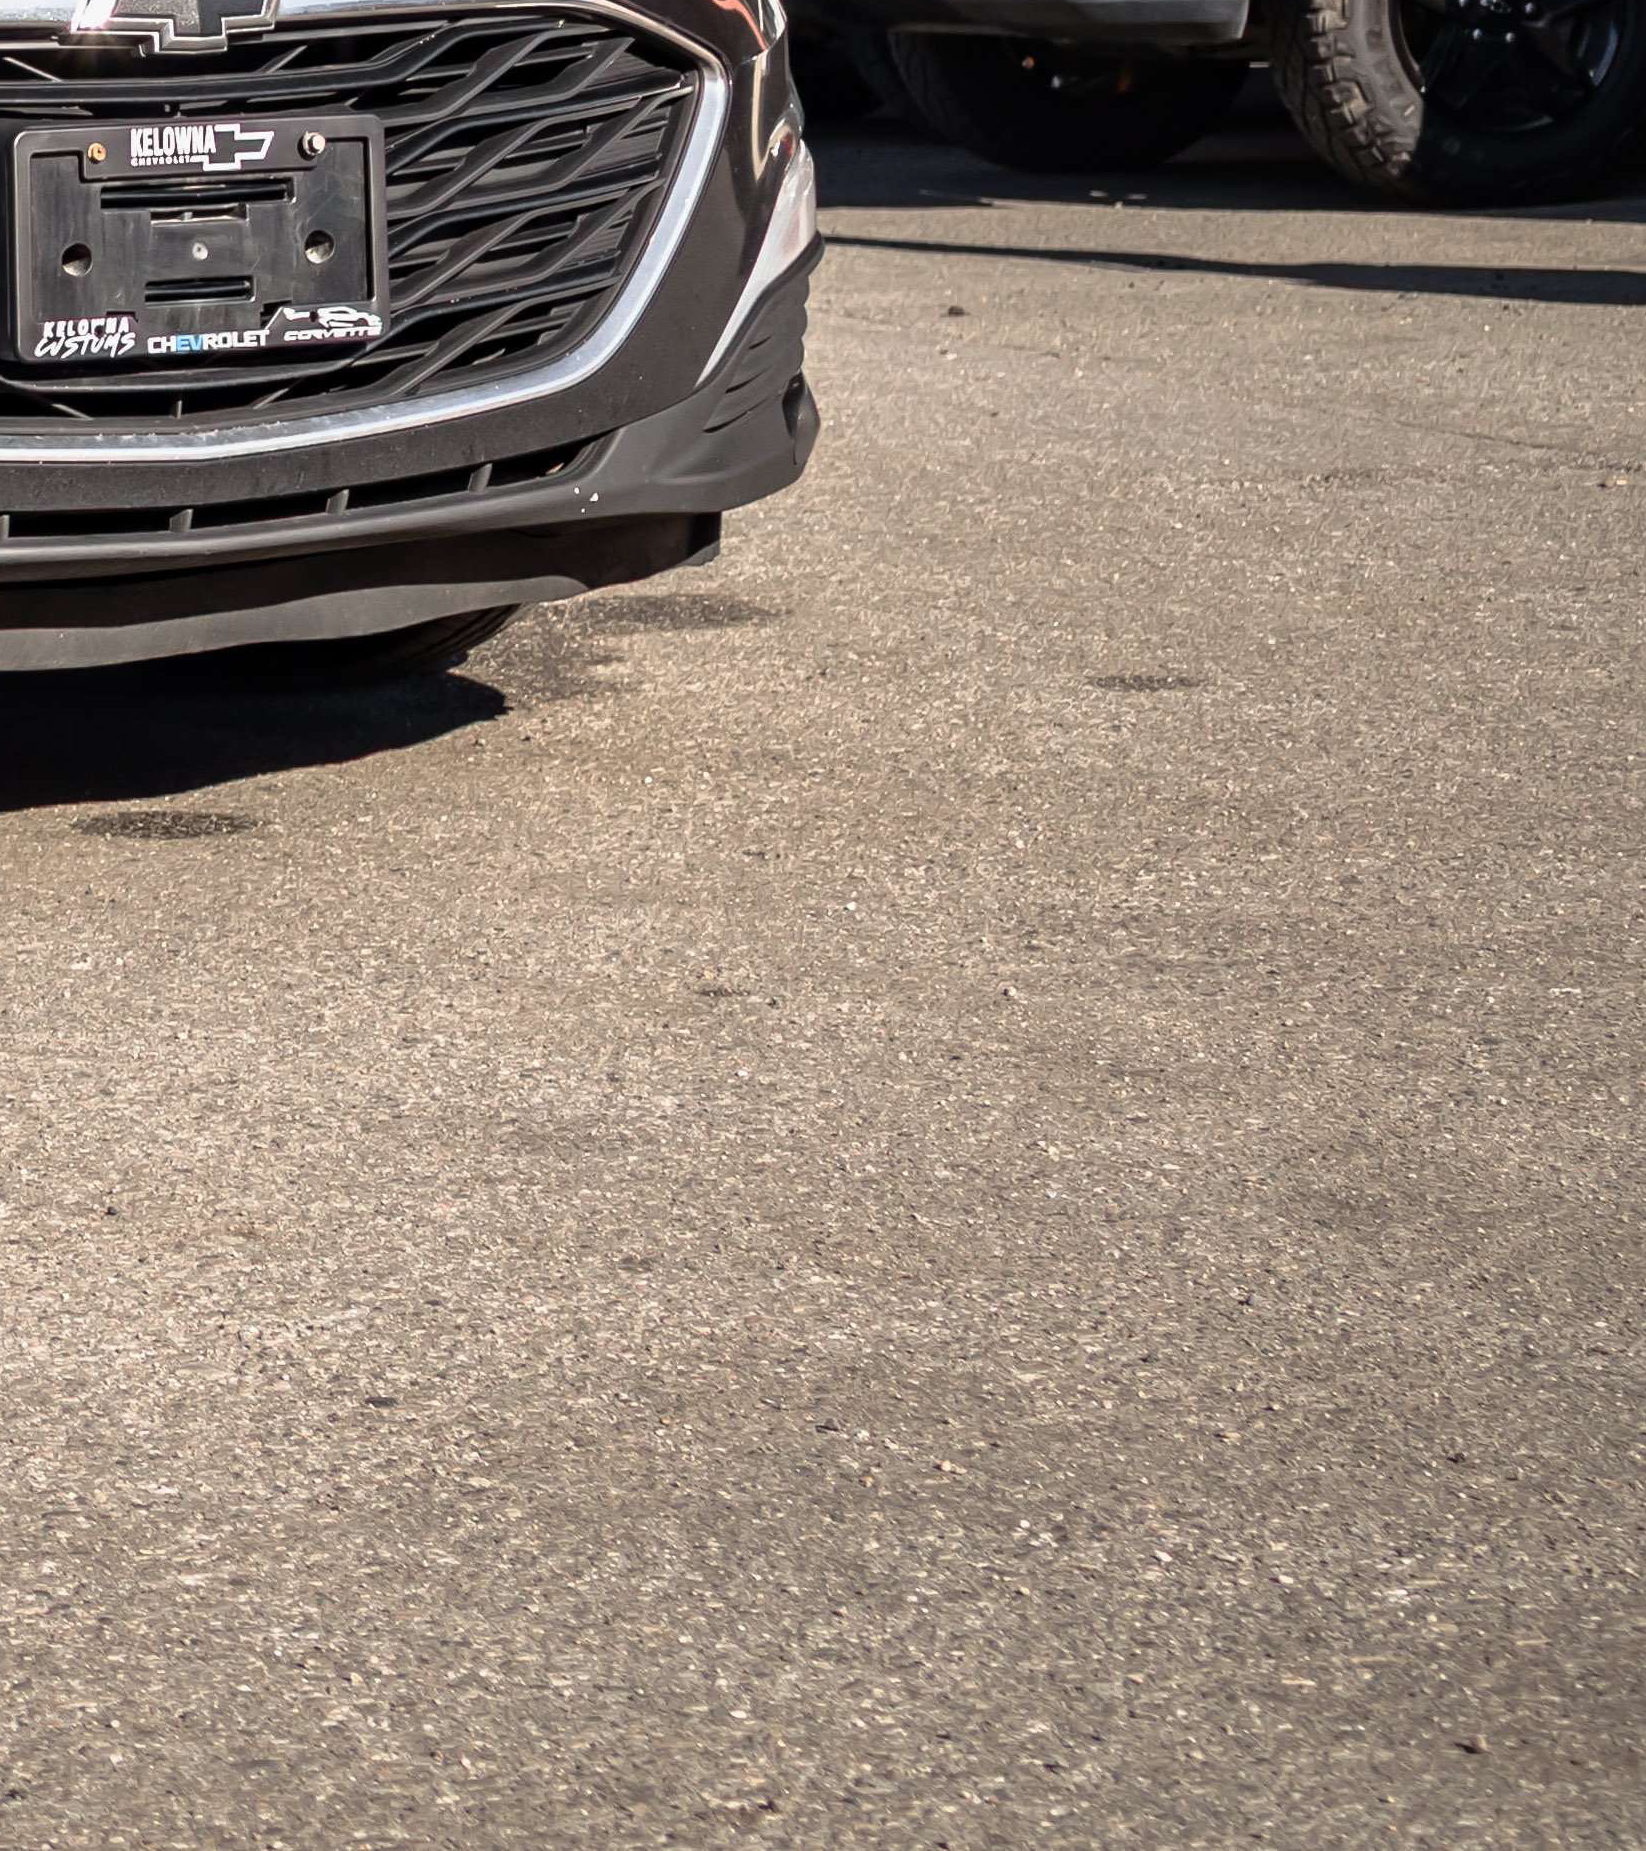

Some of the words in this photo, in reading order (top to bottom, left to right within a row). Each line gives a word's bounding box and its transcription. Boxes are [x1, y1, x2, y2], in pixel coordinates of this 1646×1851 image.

[130, 125, 216, 157] KELOWNA
[131, 155, 192, 167] CHEVROLET
[147, 329, 270, 354] CHEVROLET
